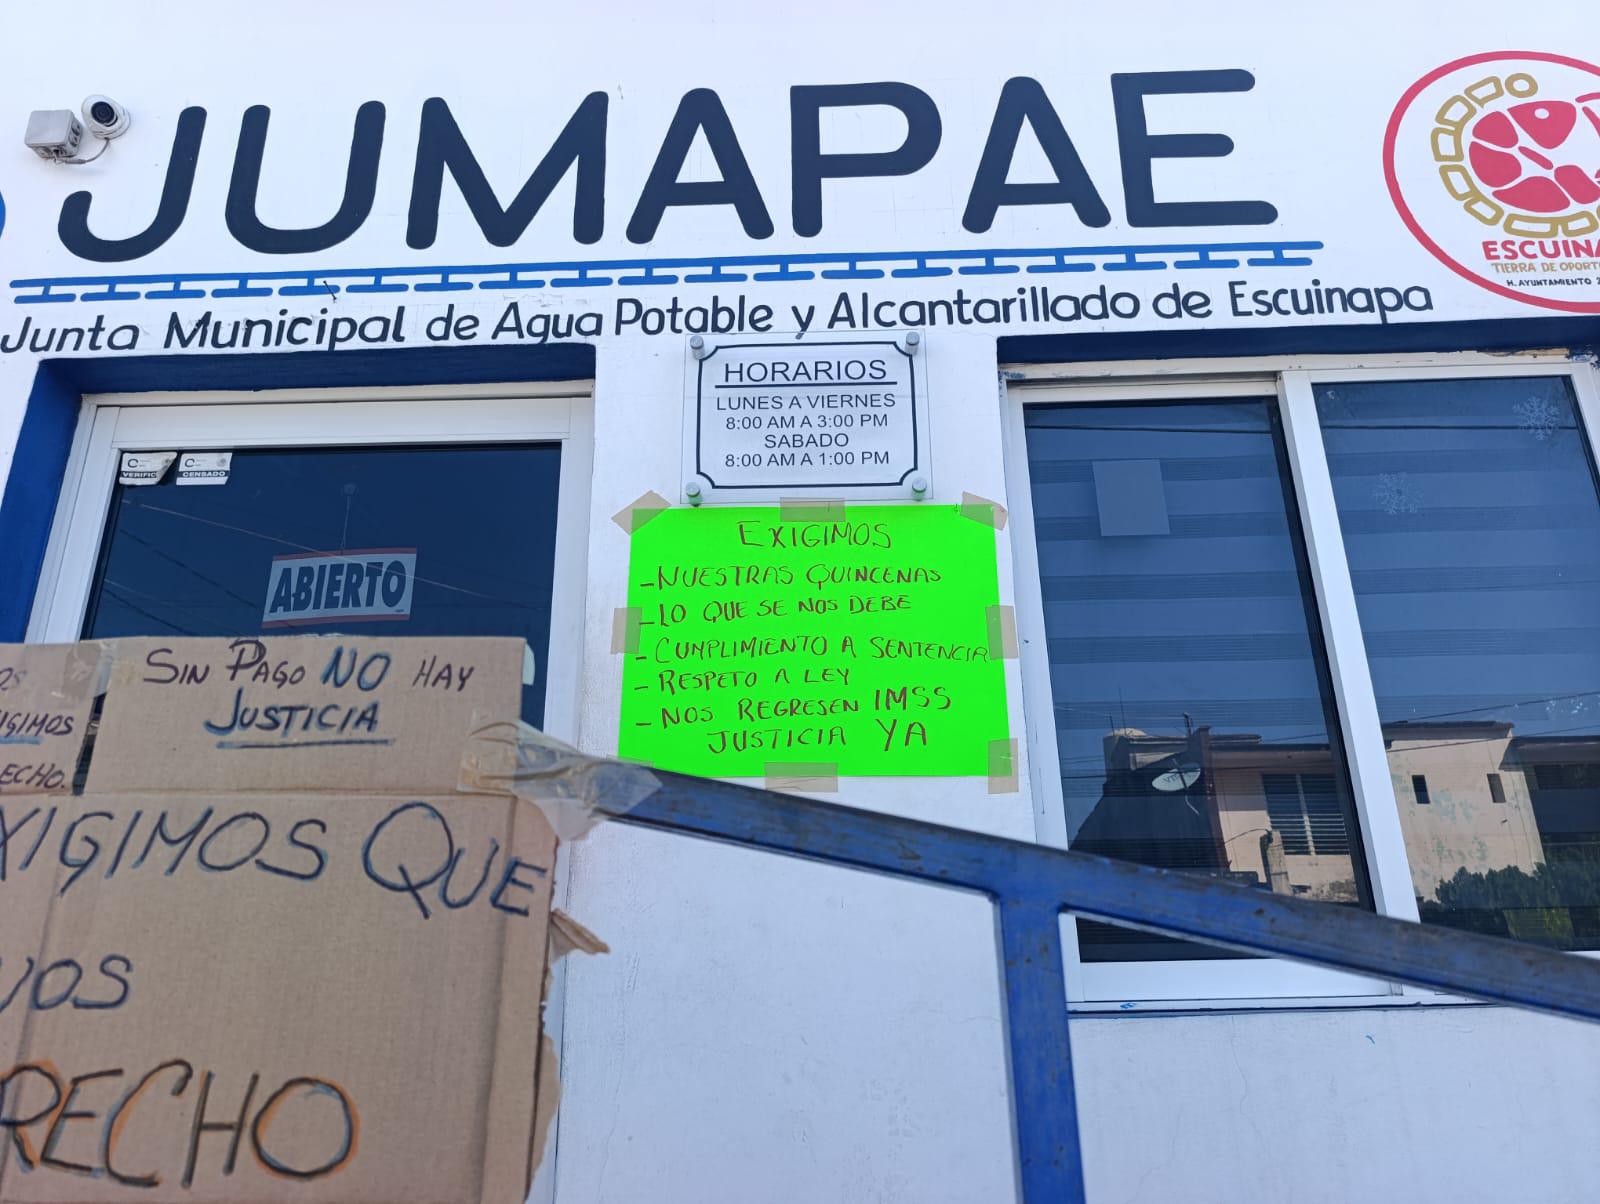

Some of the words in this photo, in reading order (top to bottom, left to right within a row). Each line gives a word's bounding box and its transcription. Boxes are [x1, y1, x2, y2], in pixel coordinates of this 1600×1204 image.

[58, 69, 1278, 262] JUMAPAE
[1491, 262, 1537, 273] TIERRA
[1541, 262, 1557, 272] DE
[1560, 261, 1600, 271] OPORT
[1519, 278, 1592, 286] AYUNTAMIENTO
[0, 315, 140, 353] Junta
[163, 308, 405, 351] Municipal
[425, 303, 479, 341] de
[491, 302, 602, 345] Agua
[615, 295, 773, 335] Potable
[792, 305, 815, 339] y
[827, 285, 1140, 329] Alcantarillado
[1153, 283, 1211, 320] de
[1229, 279, 1433, 324] Escuinapa
[724, 360, 887, 382] HORARIOS
[716, 395, 783, 410] LUNES
[788, 397, 801, 409] A
[807, 393, 896, 408] VIERNES
[726, 416, 762, 430] 8:00
[767, 416, 795, 429] AM
[800, 416, 812, 428] A
[817, 414, 854, 428] 3:00
[860, 414, 888, 427] PM
[764, 433, 849, 448] SABADO
[725, 454, 762, 467] 8:00
[767, 453, 795, 466] AM
[800, 453, 813, 466] A
[818, 452, 855, 465] 1:00
[861, 451, 889, 464] PM
[737, 521, 891, 549] EXIGIMOS
[269, 560, 406, 613] ABIERTO
[806, 563, 942, 591] QUINCENAS
[703, 600, 750, 623] QUE
[757, 599, 788, 617] SE
[798, 597, 838, 615] NOS
[849, 595, 912, 615] DEBE
[841, 635, 856, 658] A
[870, 636, 988, 663] SENTENCIA
[321, 646, 391, 691] NO
[412, 655, 474, 691] HAY
[775, 668, 790, 684] A
[804, 667, 850, 686] LEY
[738, 697, 860, 723] REGRESEN
[874, 687, 952, 711] IMSS
[707, 725, 847, 754] JUSTICIA
[876, 719, 928, 752] YA
[363, 801, 548, 919] QUE
